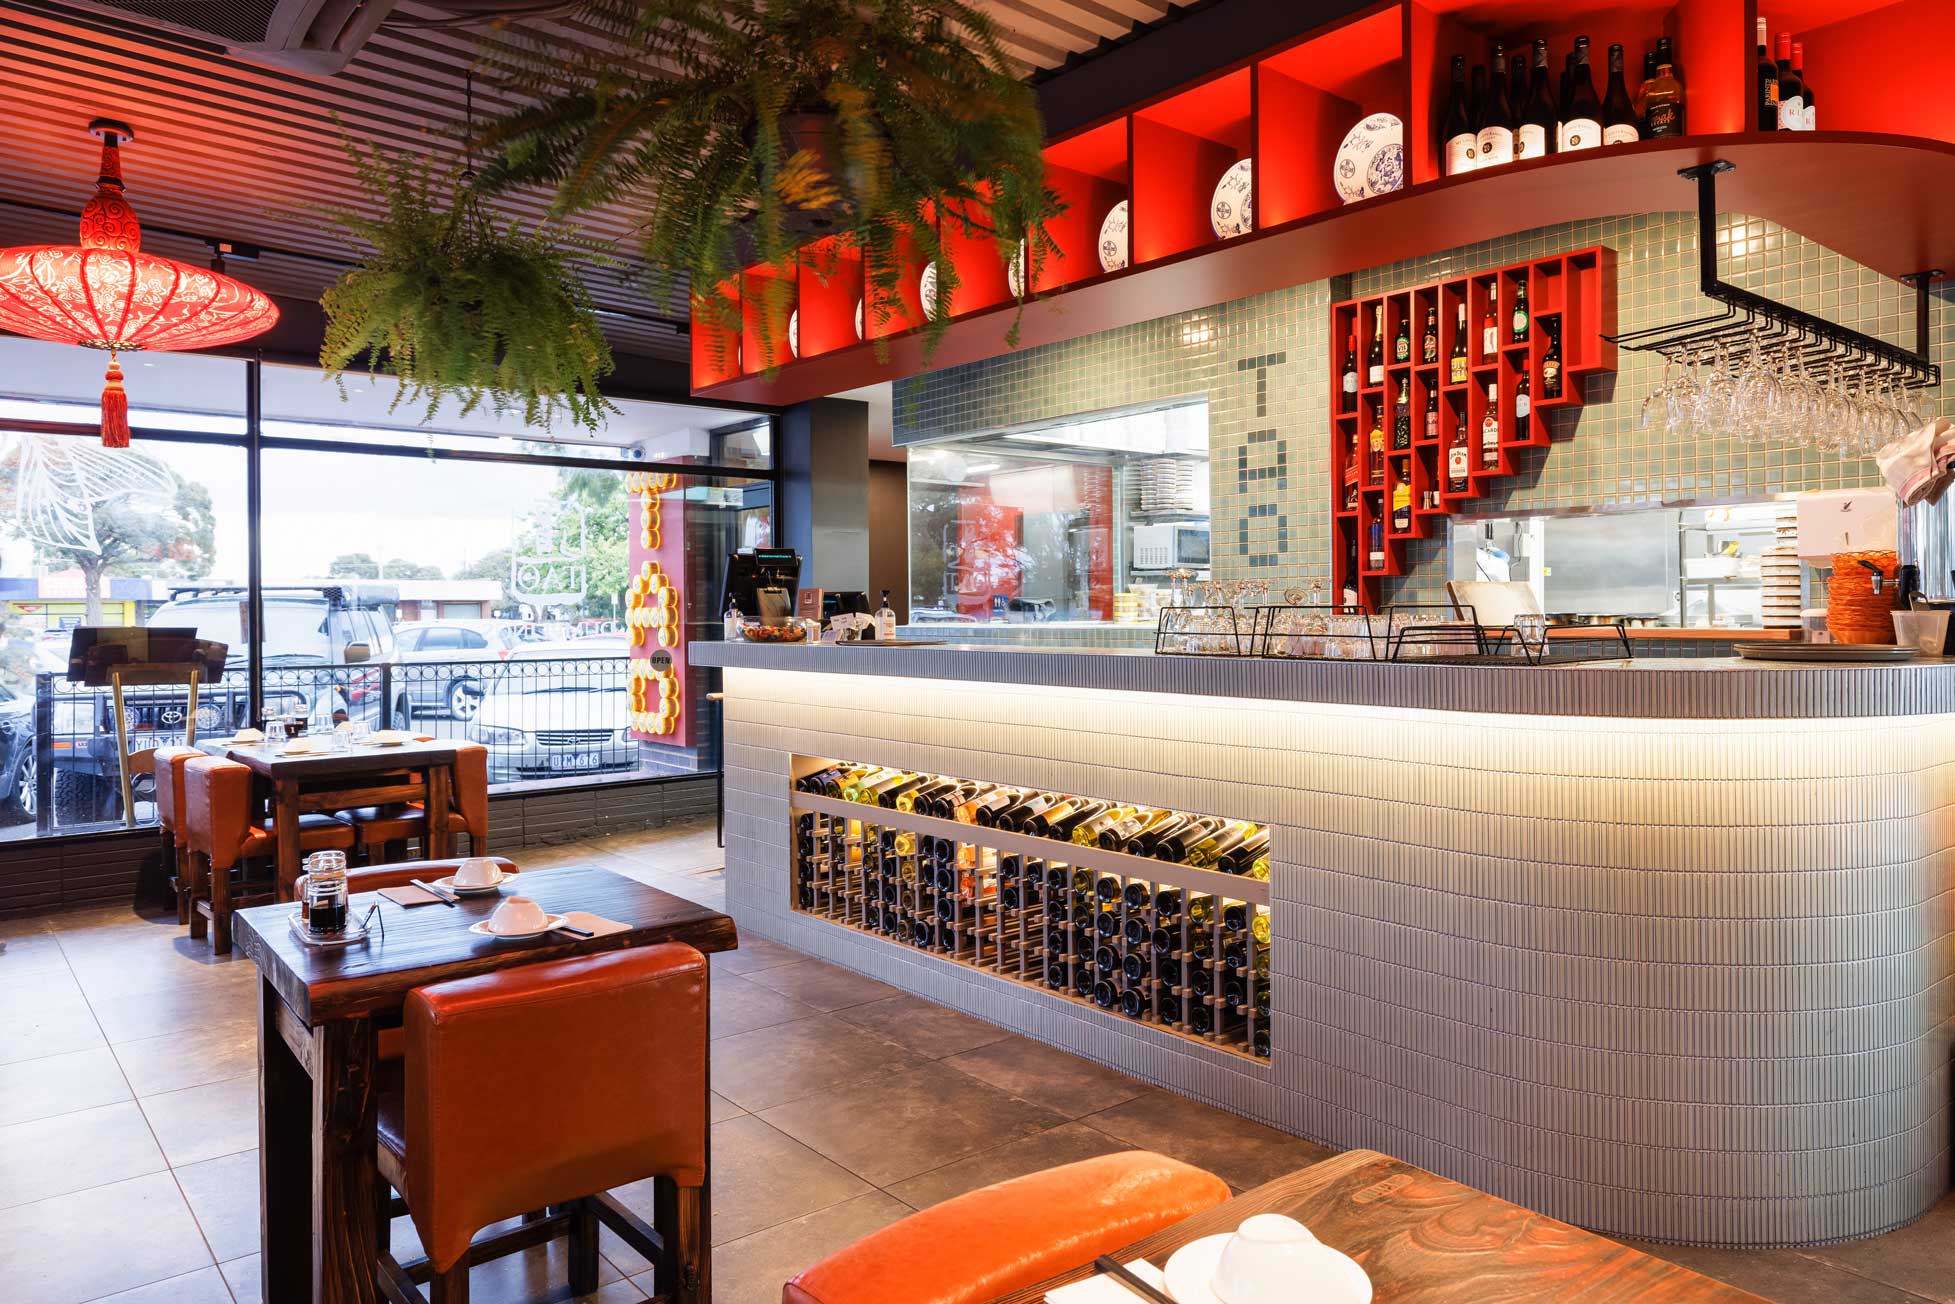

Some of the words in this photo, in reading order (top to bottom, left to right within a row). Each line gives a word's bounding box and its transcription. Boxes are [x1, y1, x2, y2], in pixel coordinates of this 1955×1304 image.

[1238, 351, 1287, 568] TAO
[625, 472, 678, 735] TAO
[651, 655, 672, 666] OPEN
